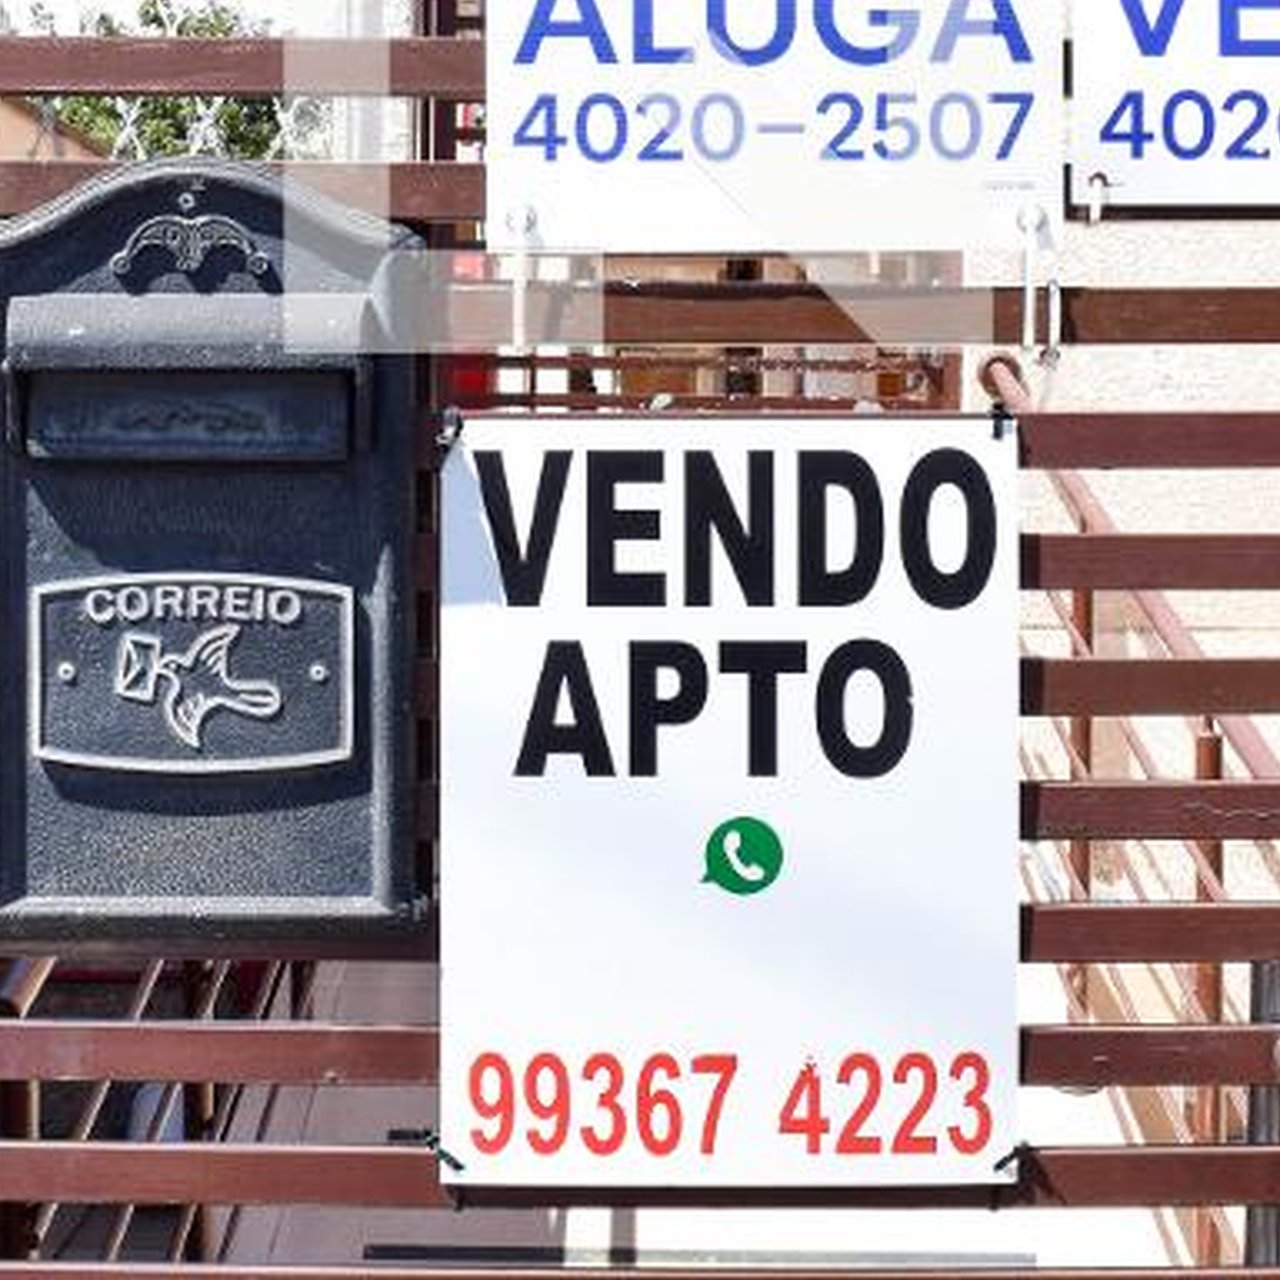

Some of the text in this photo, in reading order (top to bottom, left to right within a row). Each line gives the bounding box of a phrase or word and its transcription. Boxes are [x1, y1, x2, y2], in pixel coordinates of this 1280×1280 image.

[512, 92, 1036, 163] 4020-2507
[472, 447, 998, 610] VENDO
[84, 584, 302, 623] CORREIO
[513, 637, 914, 779] APTO
[467, 1051, 994, 1156] 99367 4223
